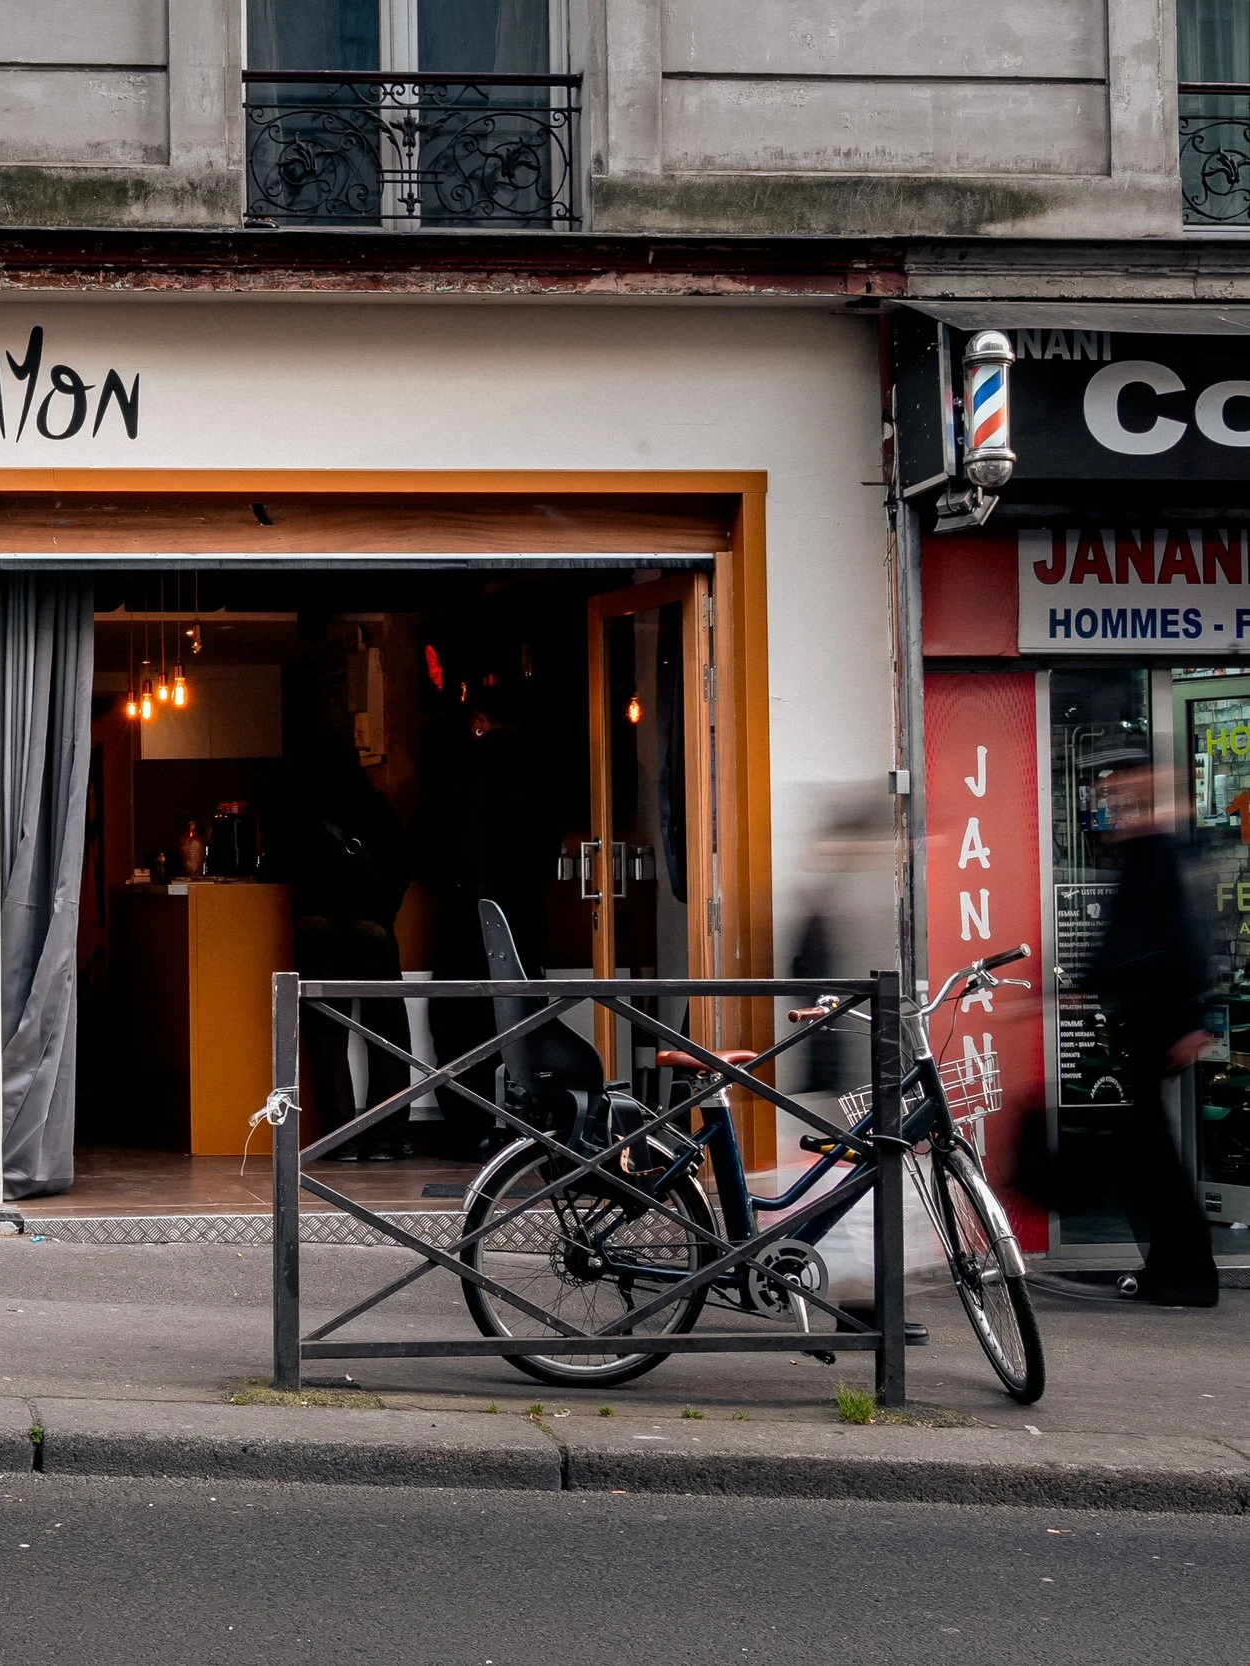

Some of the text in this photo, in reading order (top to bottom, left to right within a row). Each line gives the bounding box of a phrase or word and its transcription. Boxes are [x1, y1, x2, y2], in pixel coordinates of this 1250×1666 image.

[1004, 328, 1112, 361] NANI
[1032, 529, 1250, 585] JANAN
[1049, 607, 1203, 639] HOMMES
[1060, 1020, 1083, 1028] HOMME
